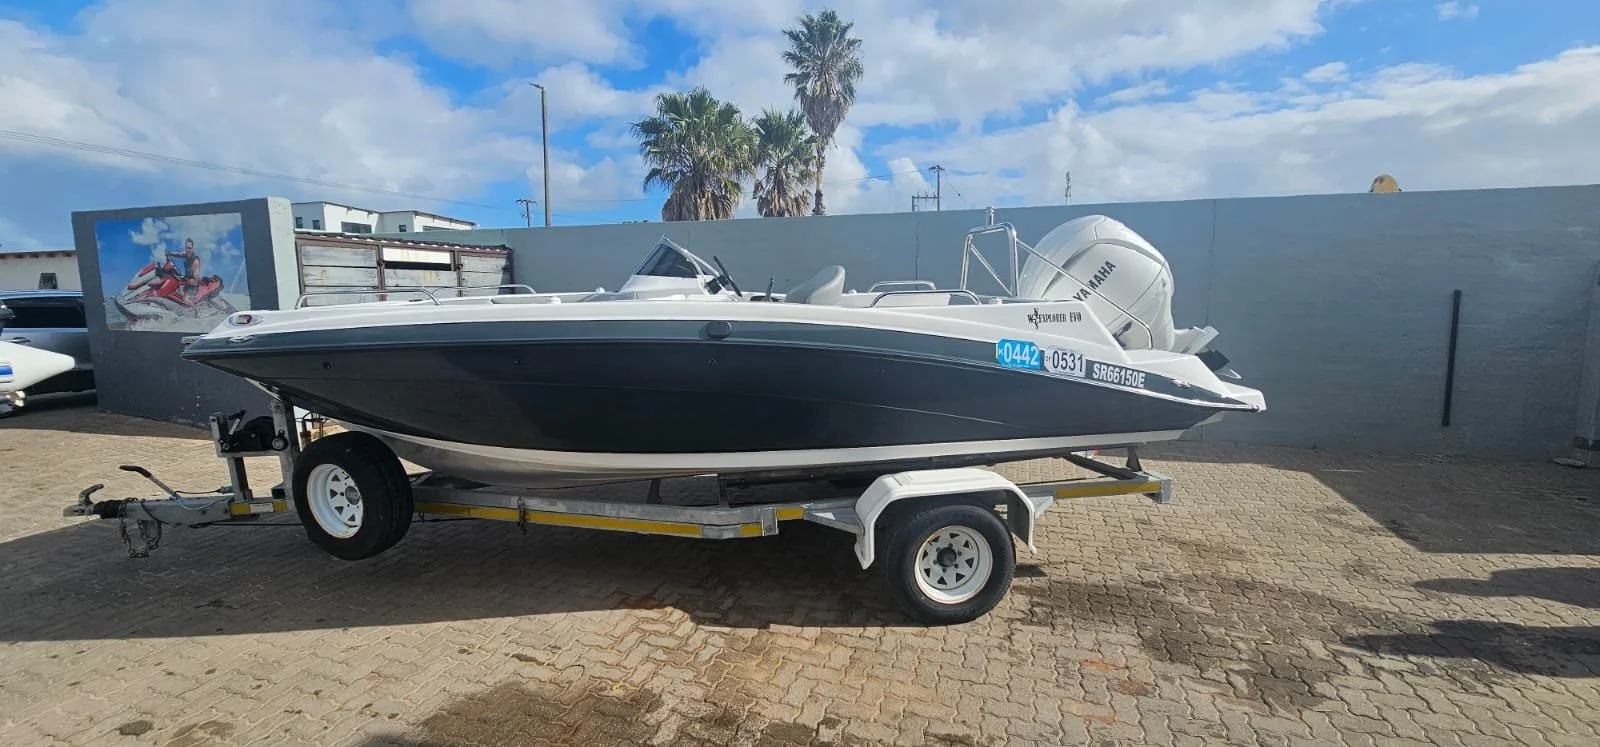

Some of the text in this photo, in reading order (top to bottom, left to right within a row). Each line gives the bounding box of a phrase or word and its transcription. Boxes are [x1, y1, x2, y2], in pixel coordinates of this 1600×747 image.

[1072, 261, 1116, 302] YAMAHA
[1069, 311, 1082, 323] EVO
[1003, 342, 1039, 366] 0442
[1052, 350, 1083, 372] 0531
[1092, 363, 1146, 388] SR66150E
